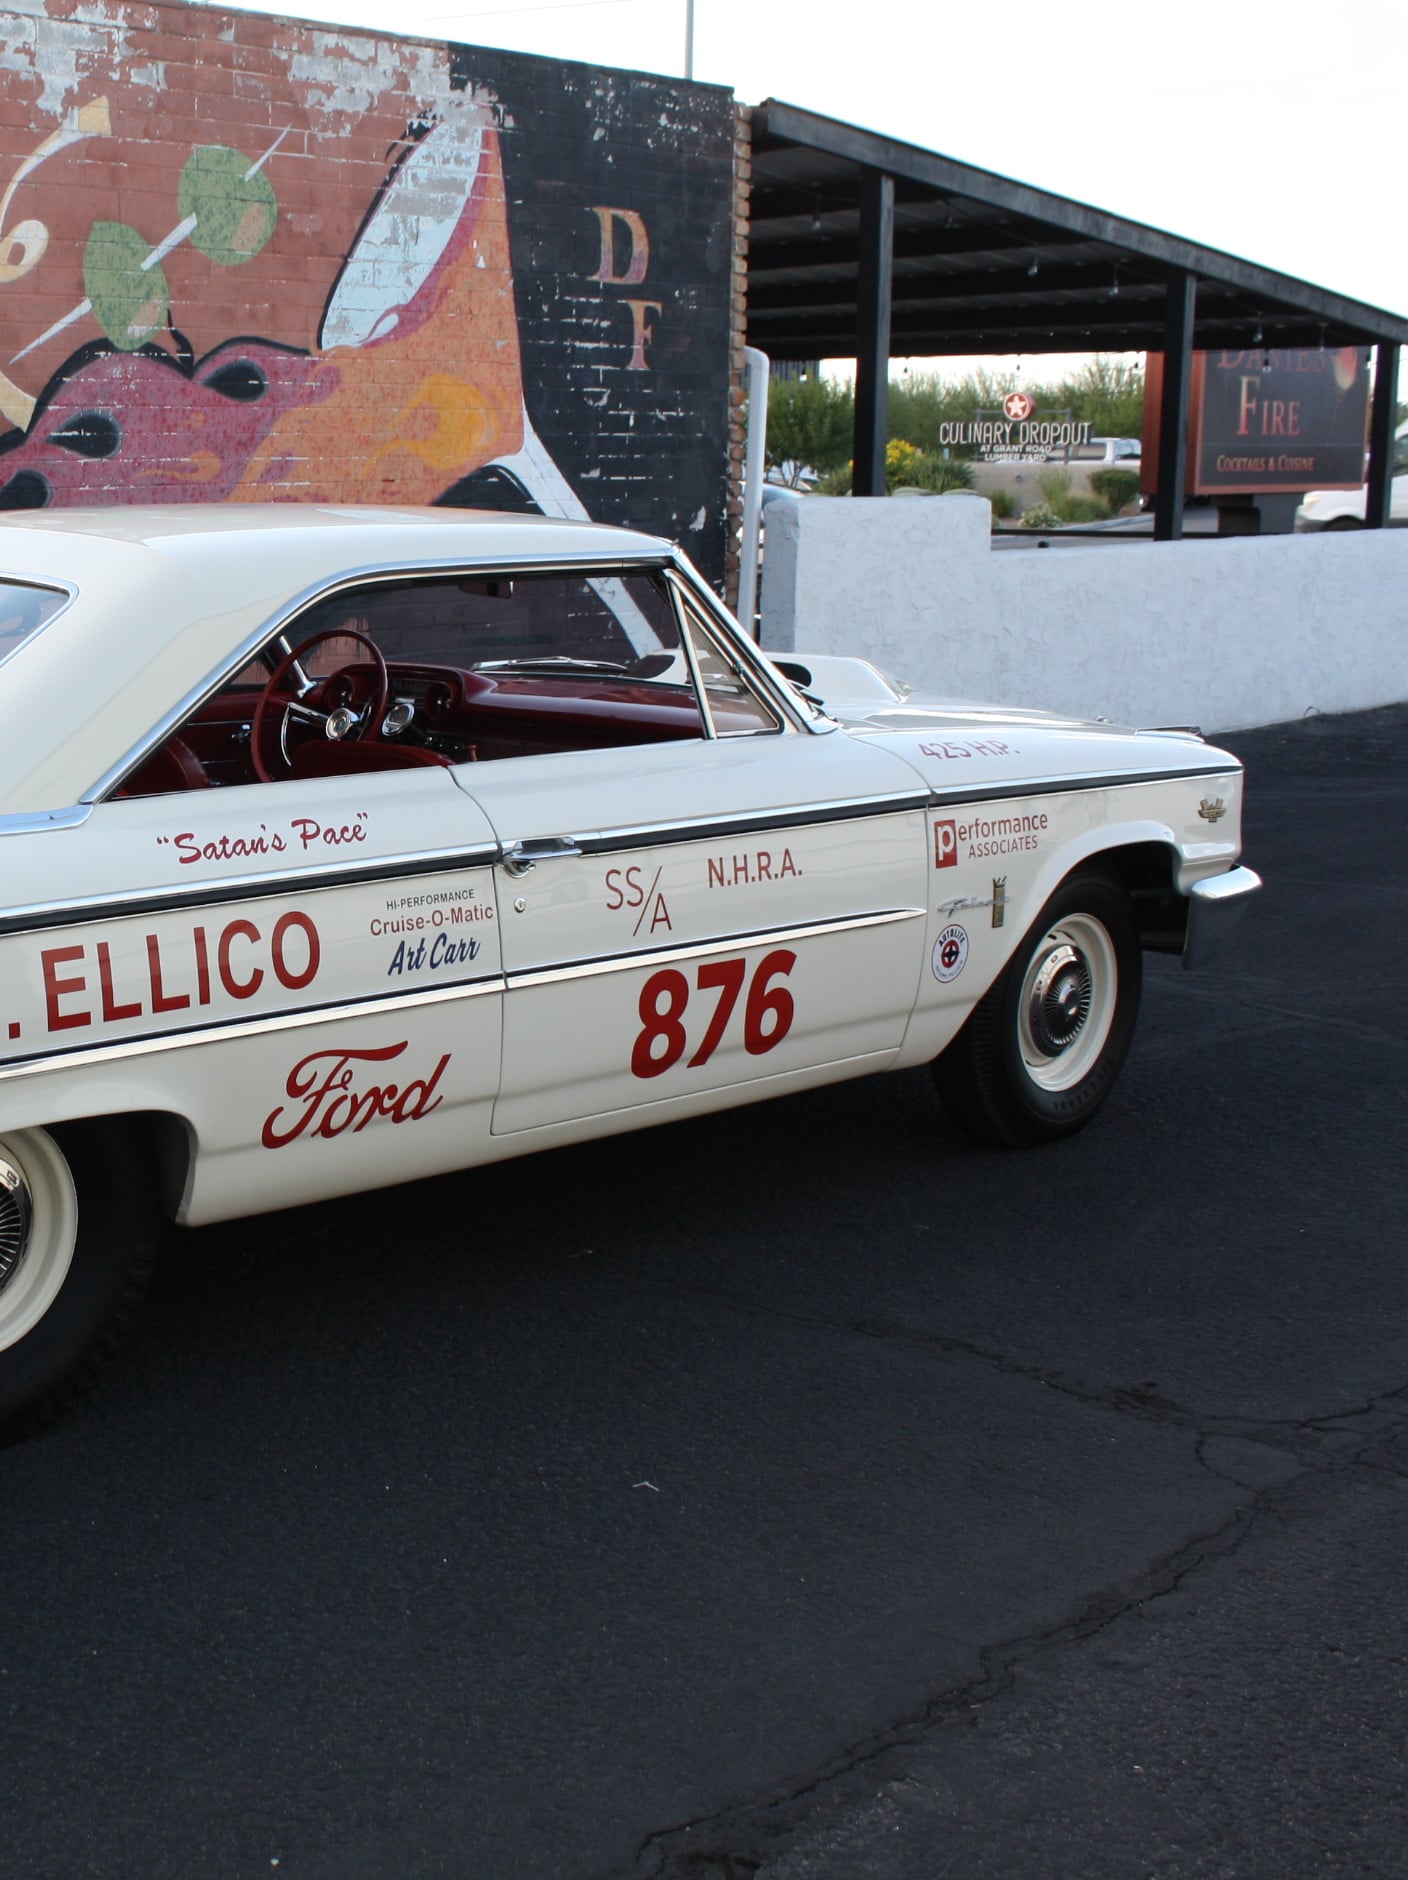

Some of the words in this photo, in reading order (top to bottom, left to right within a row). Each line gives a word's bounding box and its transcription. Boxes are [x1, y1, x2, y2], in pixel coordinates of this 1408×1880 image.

[587, 206, 650, 284] D
[622, 299, 663, 371] F
[1237, 375, 1301, 436] FIRE
[939, 422, 1013, 444] CULINARY
[1019, 422, 1092, 445] DROPOUT
[980, 444, 991, 453] AT
[993, 444, 1025, 453] GRANT
[1026, 444, 1052, 453] ROAD
[984, 453, 1020, 462] LUMBER
[1022, 453, 1047, 462] YARD
[918, 742, 971, 759] 425
[936, 814, 1049, 862] performance
[968, 835, 1038, 859] ASSOCIATES
[707, 848, 803, 889] N.H.R.A.
[370, 904, 494, 936] Cruise-O-Matic
[386, 888, 475, 911] HI-PERFORMANCE
[39, 910, 321, 1033] ELLICO
[388, 937, 428, 976] Art
[429, 932, 480, 971] Carr
[631, 949, 798, 1079] 876
[261, 1040, 452, 1149] Ford
